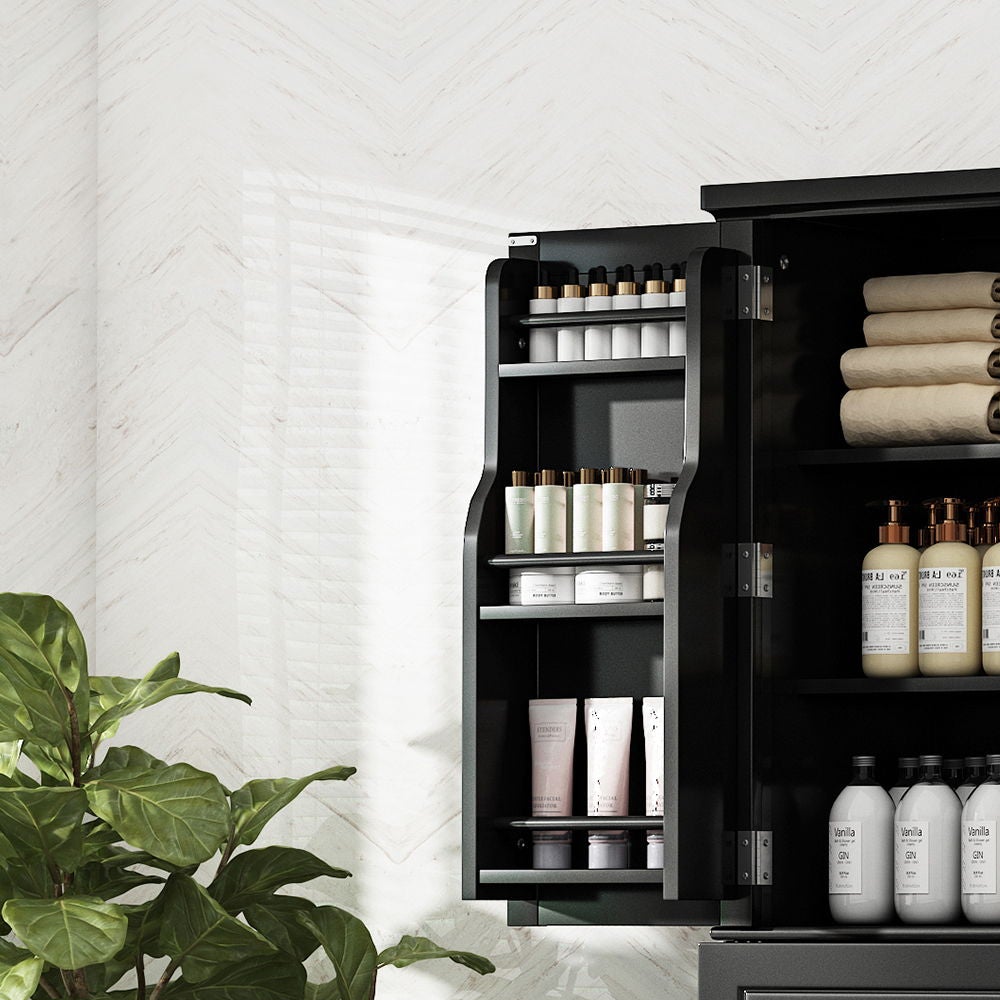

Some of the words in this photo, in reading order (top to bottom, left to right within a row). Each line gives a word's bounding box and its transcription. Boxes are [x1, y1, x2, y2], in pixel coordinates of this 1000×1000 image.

[834, 827, 855, 837] Vanilla
[901, 826, 922, 837] Vanilla
[968, 826, 989, 836] Vanilla
[838, 851, 849, 860] GIN
[905, 851, 916, 859] GIN
[972, 850, 984, 859] GIN
